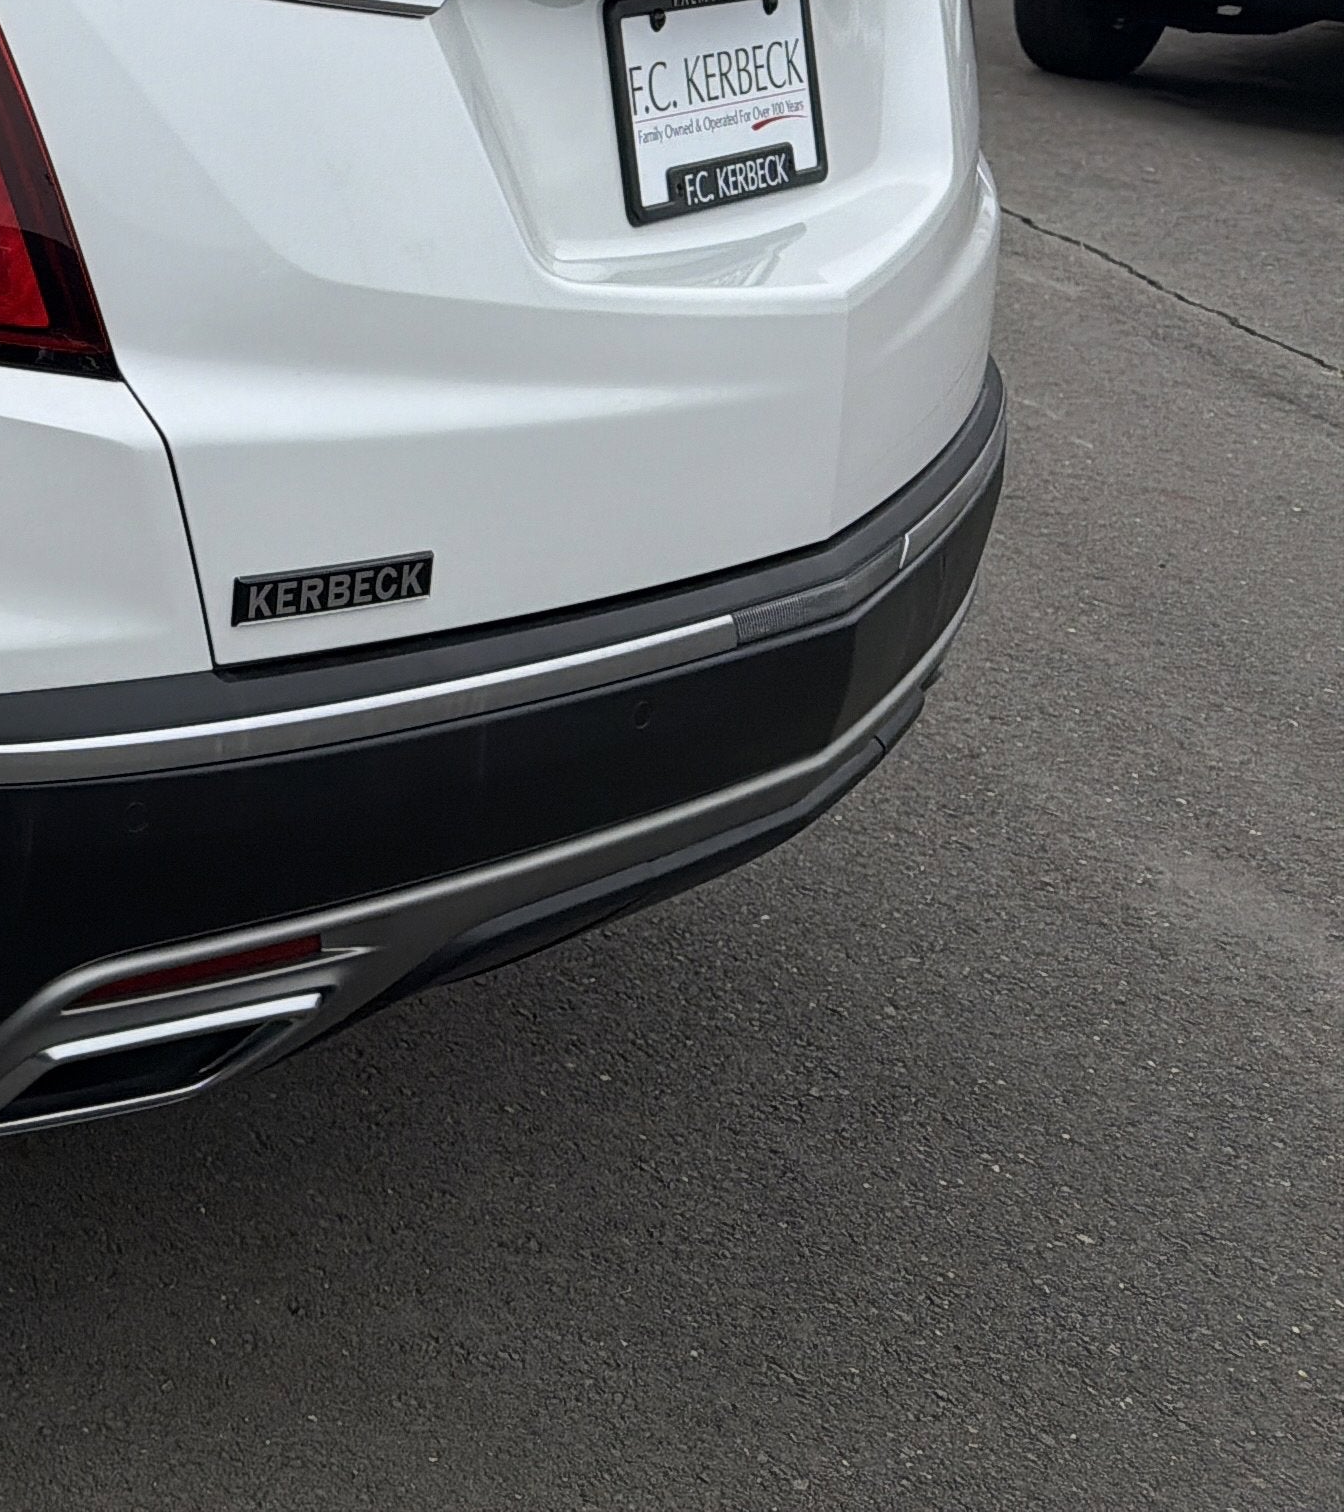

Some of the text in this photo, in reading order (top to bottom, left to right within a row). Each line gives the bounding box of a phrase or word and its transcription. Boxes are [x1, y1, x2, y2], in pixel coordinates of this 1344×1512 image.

[628, 38, 804, 116] F.C. KERBECK
[638, 99, 805, 145] Family Owned & Operated For Over 100 Years
[684, 153, 790, 206] F.C. KERBECK
[247, 562, 424, 619] KERBECK
